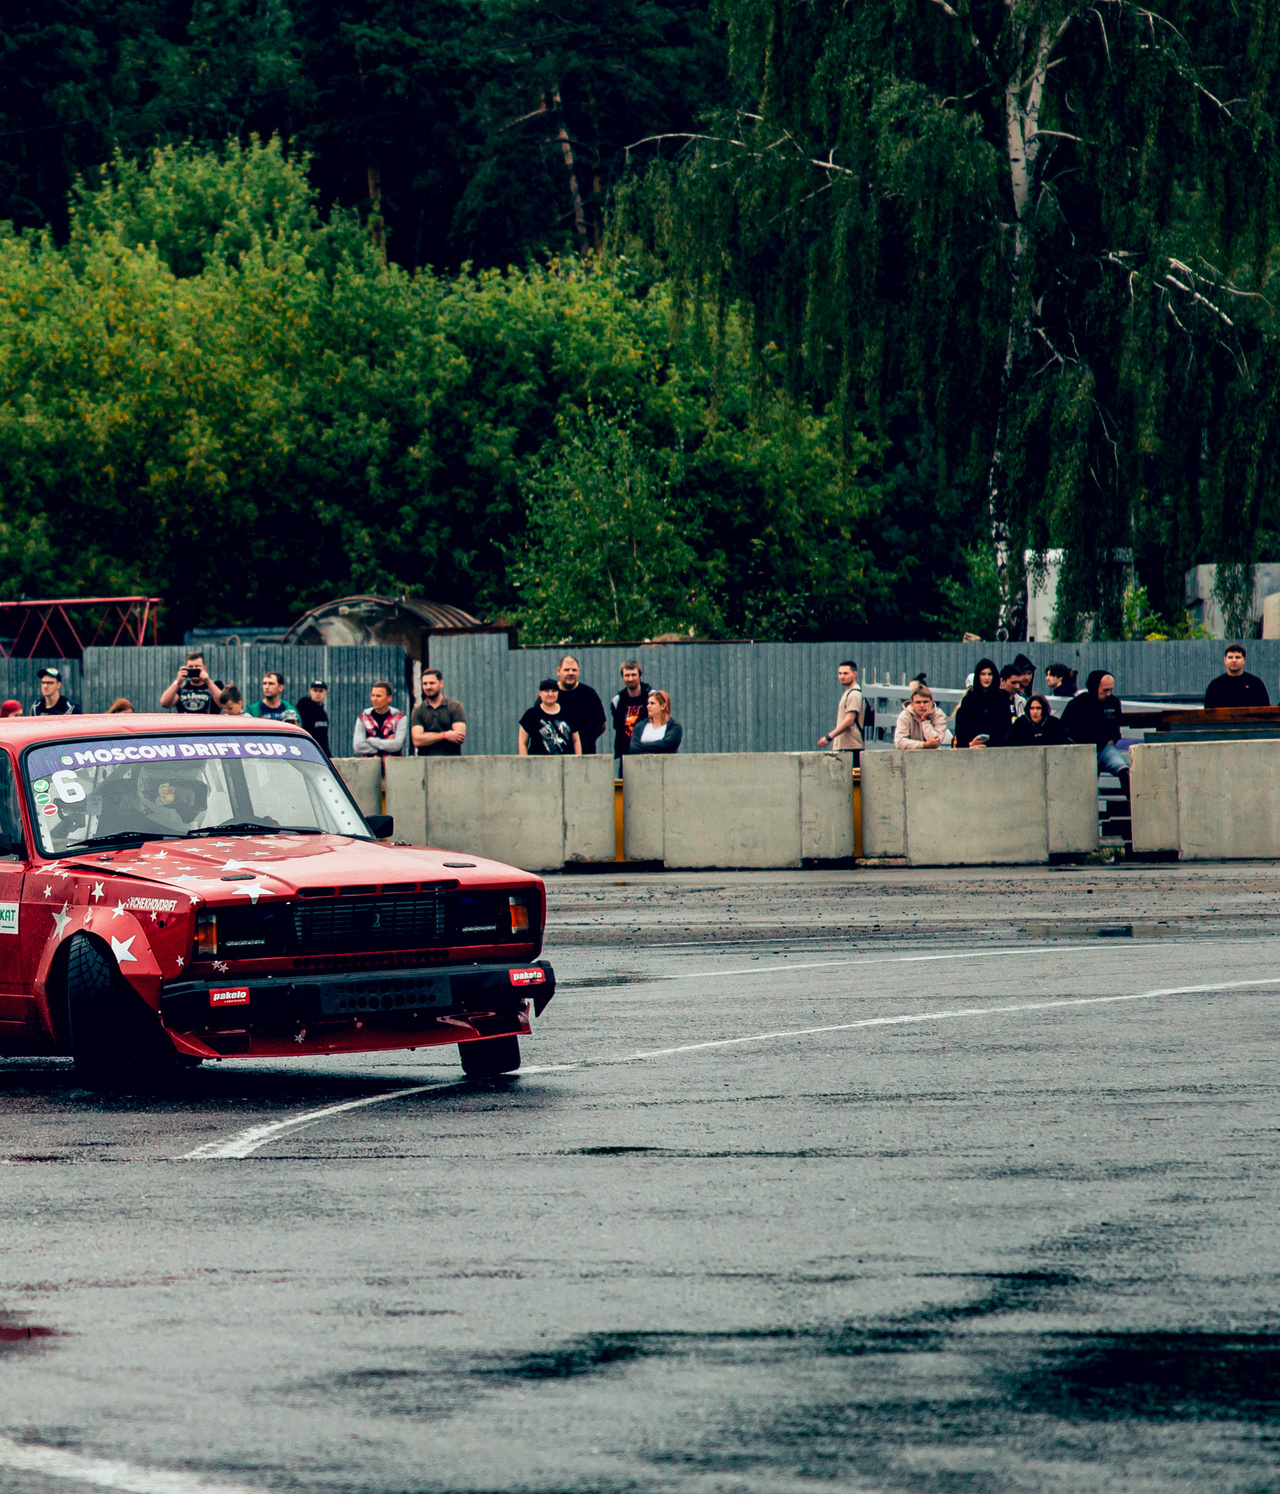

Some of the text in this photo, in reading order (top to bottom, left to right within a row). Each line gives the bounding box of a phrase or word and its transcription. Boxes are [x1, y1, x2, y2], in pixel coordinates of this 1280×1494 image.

[74, 742, 289, 765] MOSCOW DRIFT CUP
[51, 769, 86, 804] 6
[213, 991, 247, 1002] pakelo
